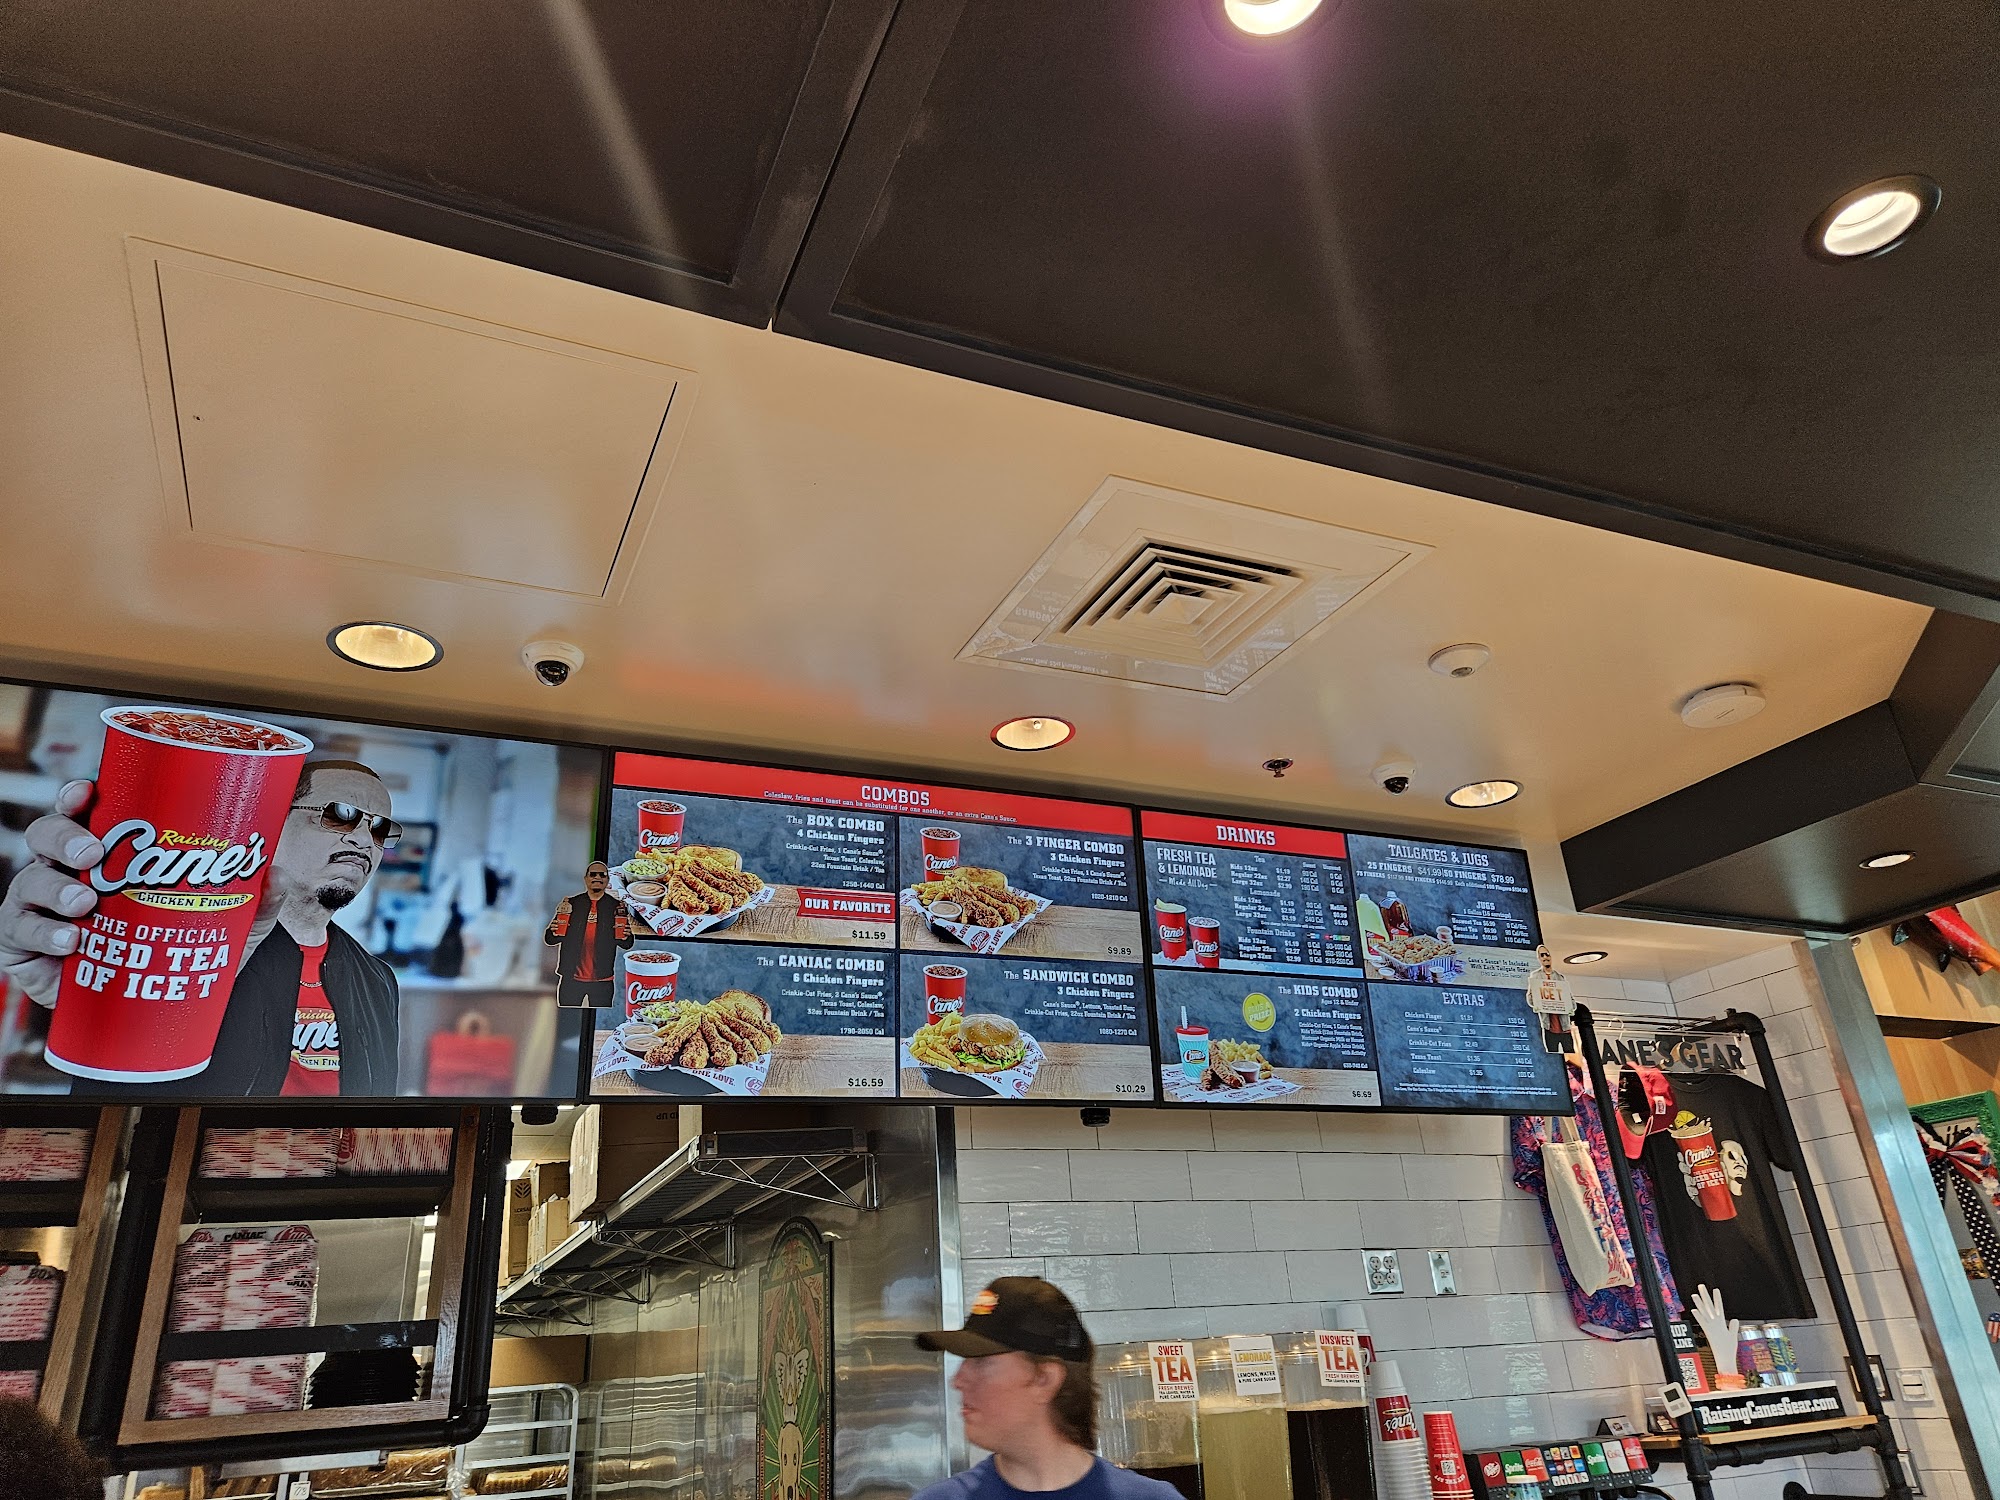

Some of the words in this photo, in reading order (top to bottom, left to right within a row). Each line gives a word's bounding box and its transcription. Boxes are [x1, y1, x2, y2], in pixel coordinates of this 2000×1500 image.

[861, 785, 930, 806] COMBOS
[764, 790, 793, 801] Coleslaw,
[795, 793, 810, 803] fries
[812, 795, 824, 803] and
[825, 796, 841, 805] toast
[864, 802, 897, 811] substituted
[922, 808, 945, 816] another,
[964, 811, 979, 819] extra
[981, 813, 998, 821] Cane's
[786, 815, 802, 825] The
[807, 814, 834, 827] BOX
[838, 818, 885, 832] COMBO
[157, 830, 230, 851] Raising
[640, 829, 680, 848] Cane's
[807, 830, 845, 841] Chicken
[848, 833, 884, 845] Fingers
[1216, 825, 1276, 846] DRINKS
[1007, 836, 1022, 845] The
[1025, 836, 1032, 846] 3
[1036, 836, 1081, 851] FINGER
[1084, 841, 1124, 855] COMBO
[90, 819, 267, 892] Cane's
[925, 854, 957, 870] Cane's
[1050, 853, 1056, 861] 3
[1059, 853, 1091, 865] Chicken
[1093, 857, 1125, 868] Fingers
[1156, 848, 1192, 863] FRESH
[1195, 851, 1216, 865] TEA
[1254, 855, 1265, 863] Tea
[1388, 844, 1448, 863] TAILGATES
[1450, 851, 1460, 864] &
[1462, 853, 1489, 867] JUGS
[1158, 863, 1166, 873] &
[1168, 864, 1217, 878] LEMONADE
[1367, 861, 1378, 870] 25
[1378, 863, 1412, 874] FINGERS
[1417, 867, 1442, 877] $41.99
[1454, 871, 1487, 881] FINGERS
[1491, 874, 1514, 884] $78.99
[138, 892, 194, 906] CHICKEN
[1249, 888, 1280, 897] Lemonade
[805, 898, 829, 910] OUR
[833, 900, 891, 914] FAVORITE
[1476, 901, 1495, 911] JUGS
[92, 913, 128, 936] THE
[135, 925, 227, 944] OFFICIAL
[852, 930, 886, 940] $11.59
[1159, 925, 1184, 939] Cane's
[1247, 926, 1274, 935] Fountain
[1275, 929, 1295, 937] Drinks
[77, 927, 152, 970] ICED
[167, 944, 230, 972] TEA
[1107, 946, 1131, 956] $9.89
[1193, 939, 1218, 954] Cane's
[757, 956, 773, 966] The
[778, 955, 832, 969] CANIAC
[836, 958, 885, 971] COMBO
[75, 960, 116, 992] OF
[124, 973, 189, 1001] ICE
[198, 973, 219, 998] T
[793, 973, 800, 982] 6
[803, 973, 843, 984] Chicken
[846, 976, 884, 988] Fingers
[1004, 971, 1019, 980] The
[1023, 969, 1089, 984] SANDWICH
[1092, 973, 1134, 986] COMBO
[627, 981, 673, 1004] Cane's
[1057, 986, 1063, 995] 3
[1066, 987, 1100, 997] Chicken
[1102, 988, 1135, 999] Fingers
[1278, 986, 1292, 994] The
[1294, 984, 1319, 996] KIDS
[1322, 986, 1358, 998] COMBO
[1540, 988, 1555, 1000] ICE
[1557, 989, 1562, 1000] T
[928, 995, 964, 1014] Cane's
[1442, 992, 1485, 1006] EXTRAS
[1294, 1008, 1300, 1016] 2
[1301, 1008, 1331, 1019] Chicken
[1332, 1010, 1361, 1021] Fingers
[1404, 1011, 1425, 1019] Chicken
[1425, 1013, 1442, 1021] Finger
[1408, 1039, 1438, 1047] Crinkle-Cut
[1602, 1038, 1674, 1068] ANE'S
[1678, 1043, 1747, 1070] GEAR
[848, 1078, 884, 1087] $16.59
[1115, 1085, 1146, 1093] $10.29
[1685, 1145, 1716, 1167] Cane's
[1319, 1335, 1354, 1346] UNSWEET
[1673, 1337, 1694, 1348] LINE
[1158, 1345, 1183, 1355] SWEET
[1235, 1352, 1273, 1362] LEMONADE
[1321, 1346, 1359, 1371] TEA
[1153, 1357, 1194, 1382] TEA
[1701, 1396, 1839, 1425] RaisingCanesGear.com
[1587, 1454, 1606, 1465] Sprite
[1504, 1463, 1524, 1474] Sprite
